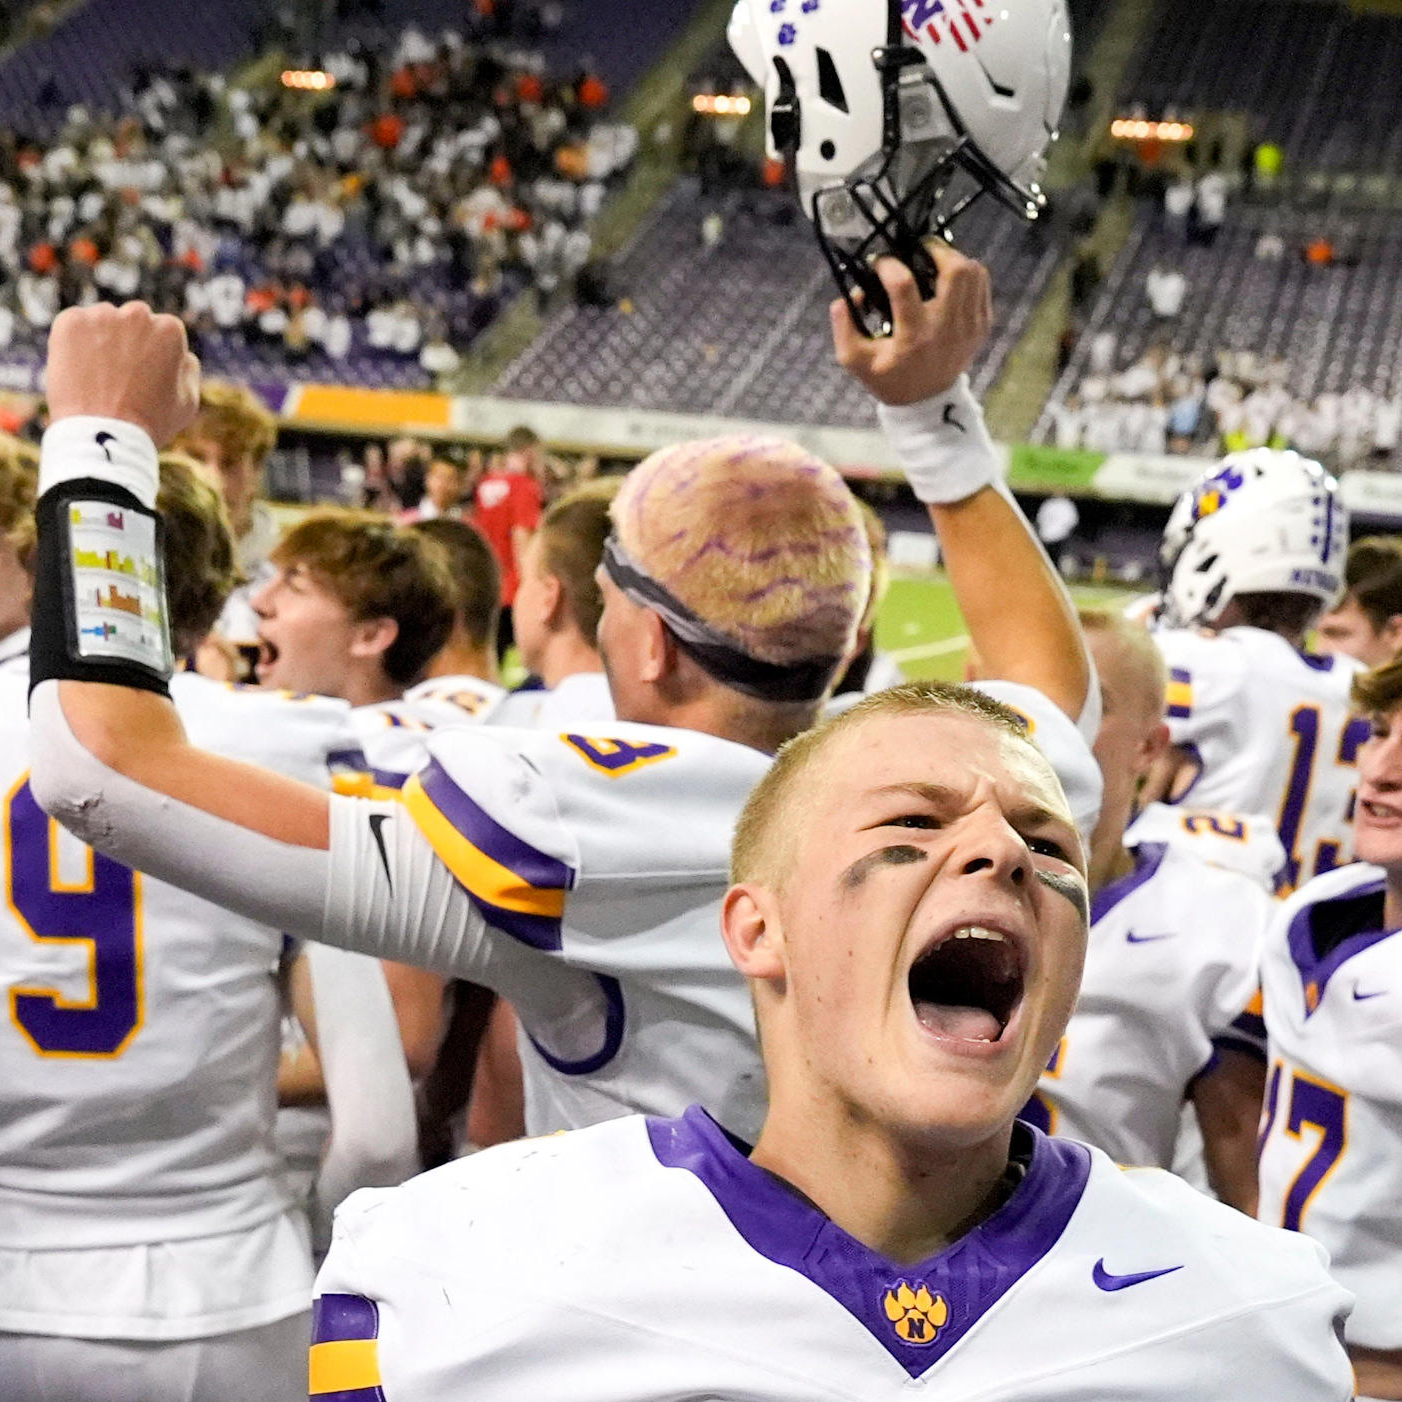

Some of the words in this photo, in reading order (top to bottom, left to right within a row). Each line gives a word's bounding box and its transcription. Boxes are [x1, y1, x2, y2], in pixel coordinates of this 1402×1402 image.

[3, 768, 146, 1060] 9
[1257, 1057, 1351, 1233] 17
[907, 1317, 925, 1339] N
